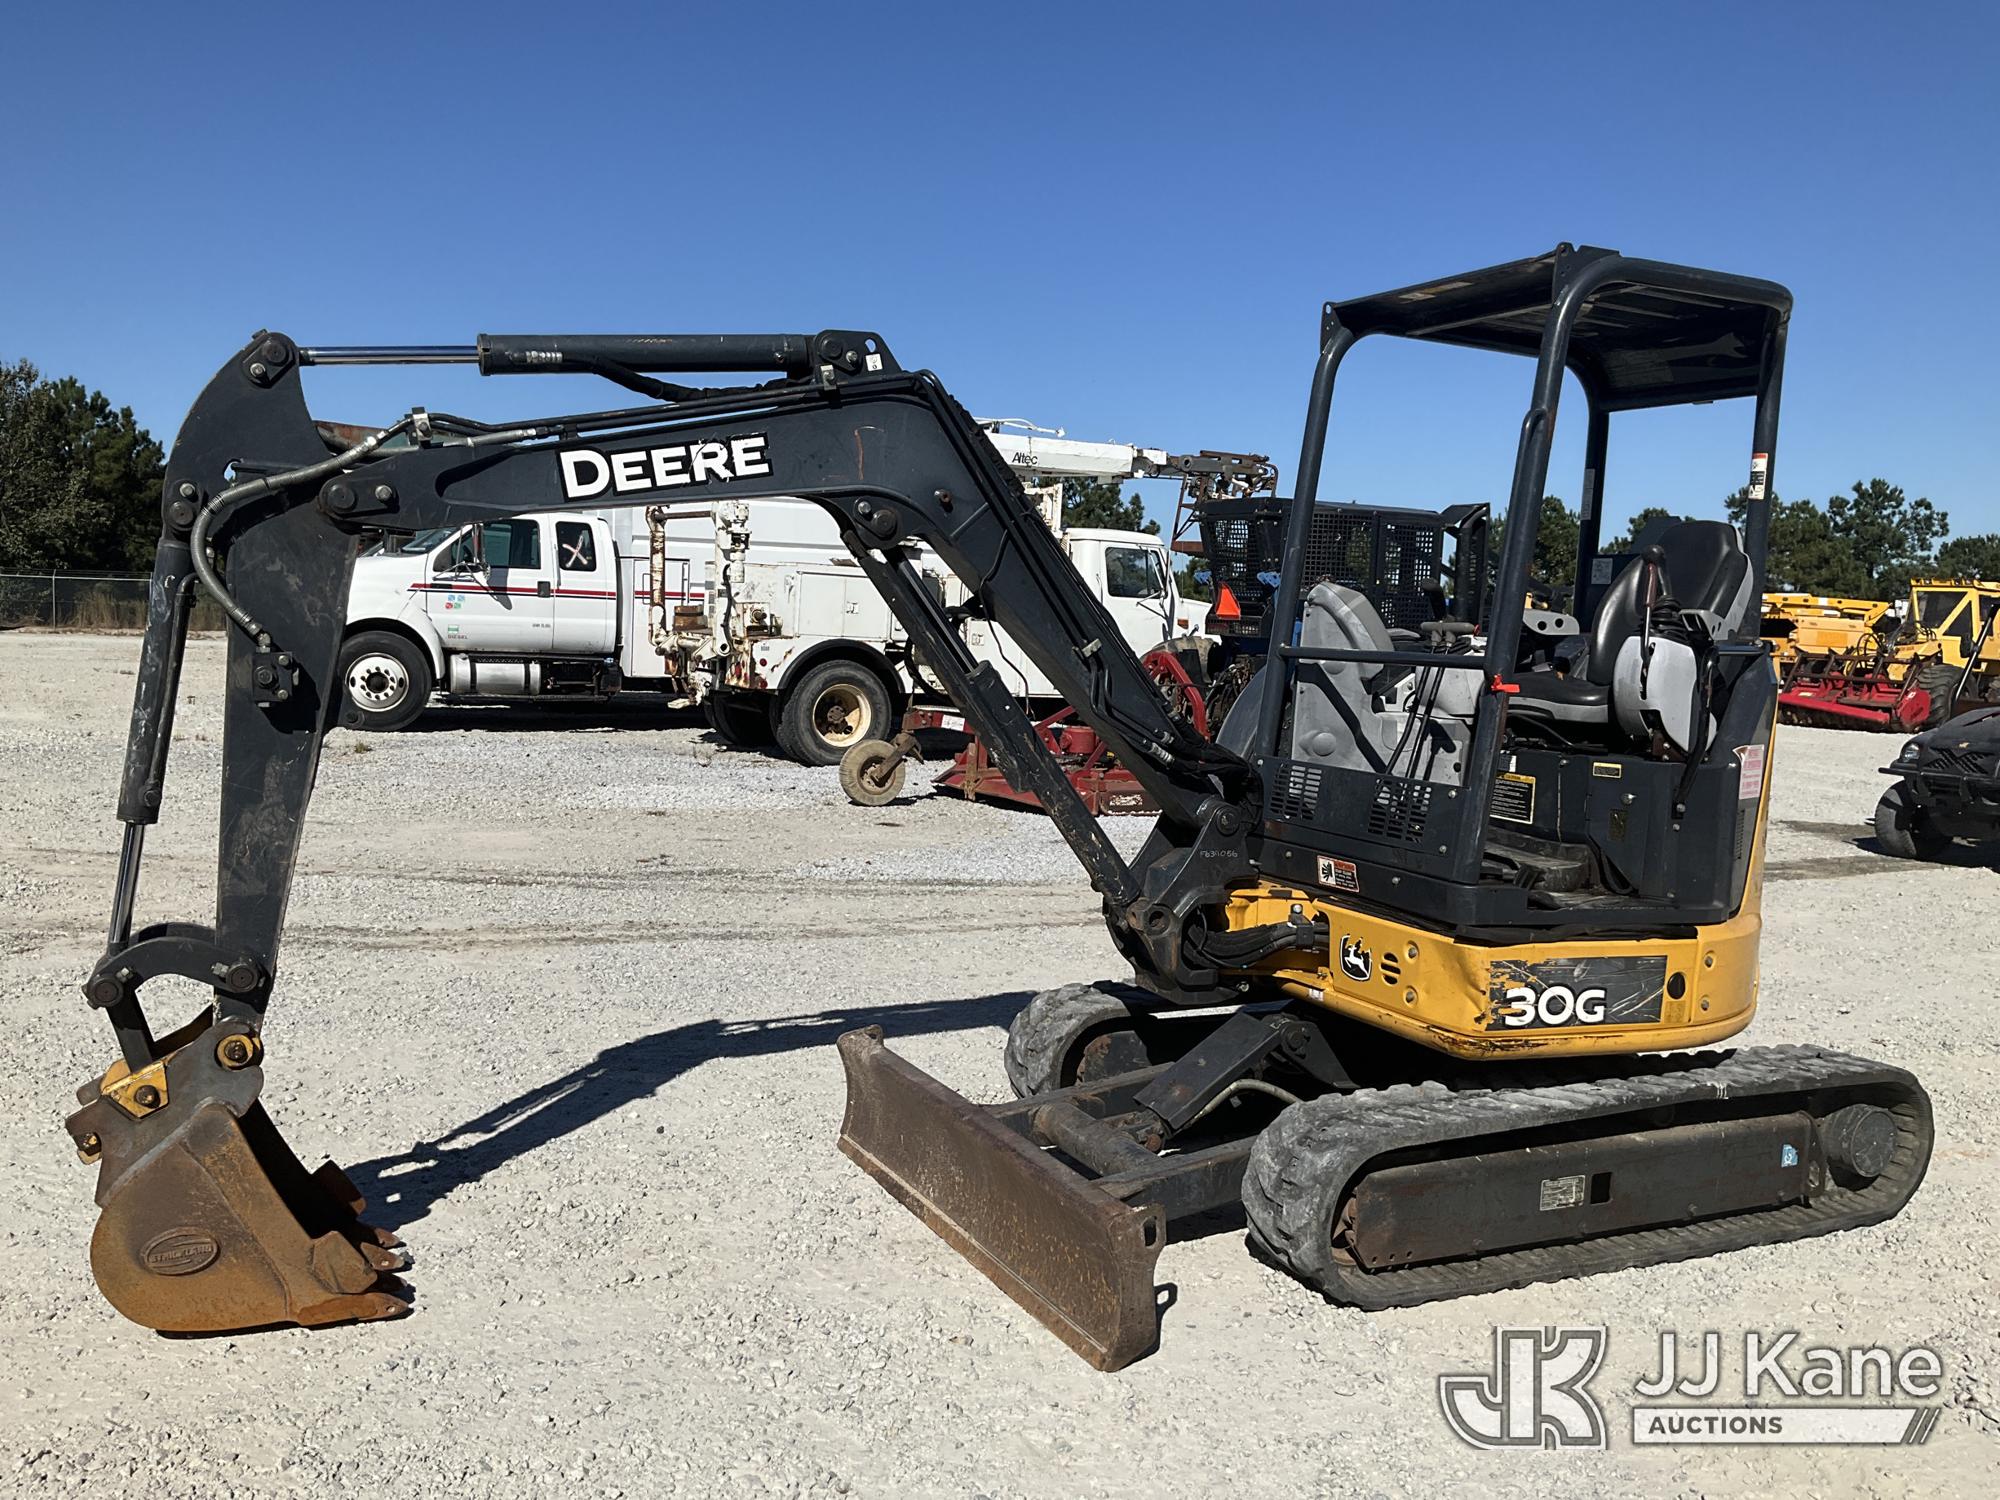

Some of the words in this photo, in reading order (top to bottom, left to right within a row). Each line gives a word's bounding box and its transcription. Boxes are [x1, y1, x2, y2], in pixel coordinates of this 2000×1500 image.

[560, 436, 769, 499] DEERE
[1012, 453, 1038, 465] Altec
[1504, 985, 1606, 1027] 30G
